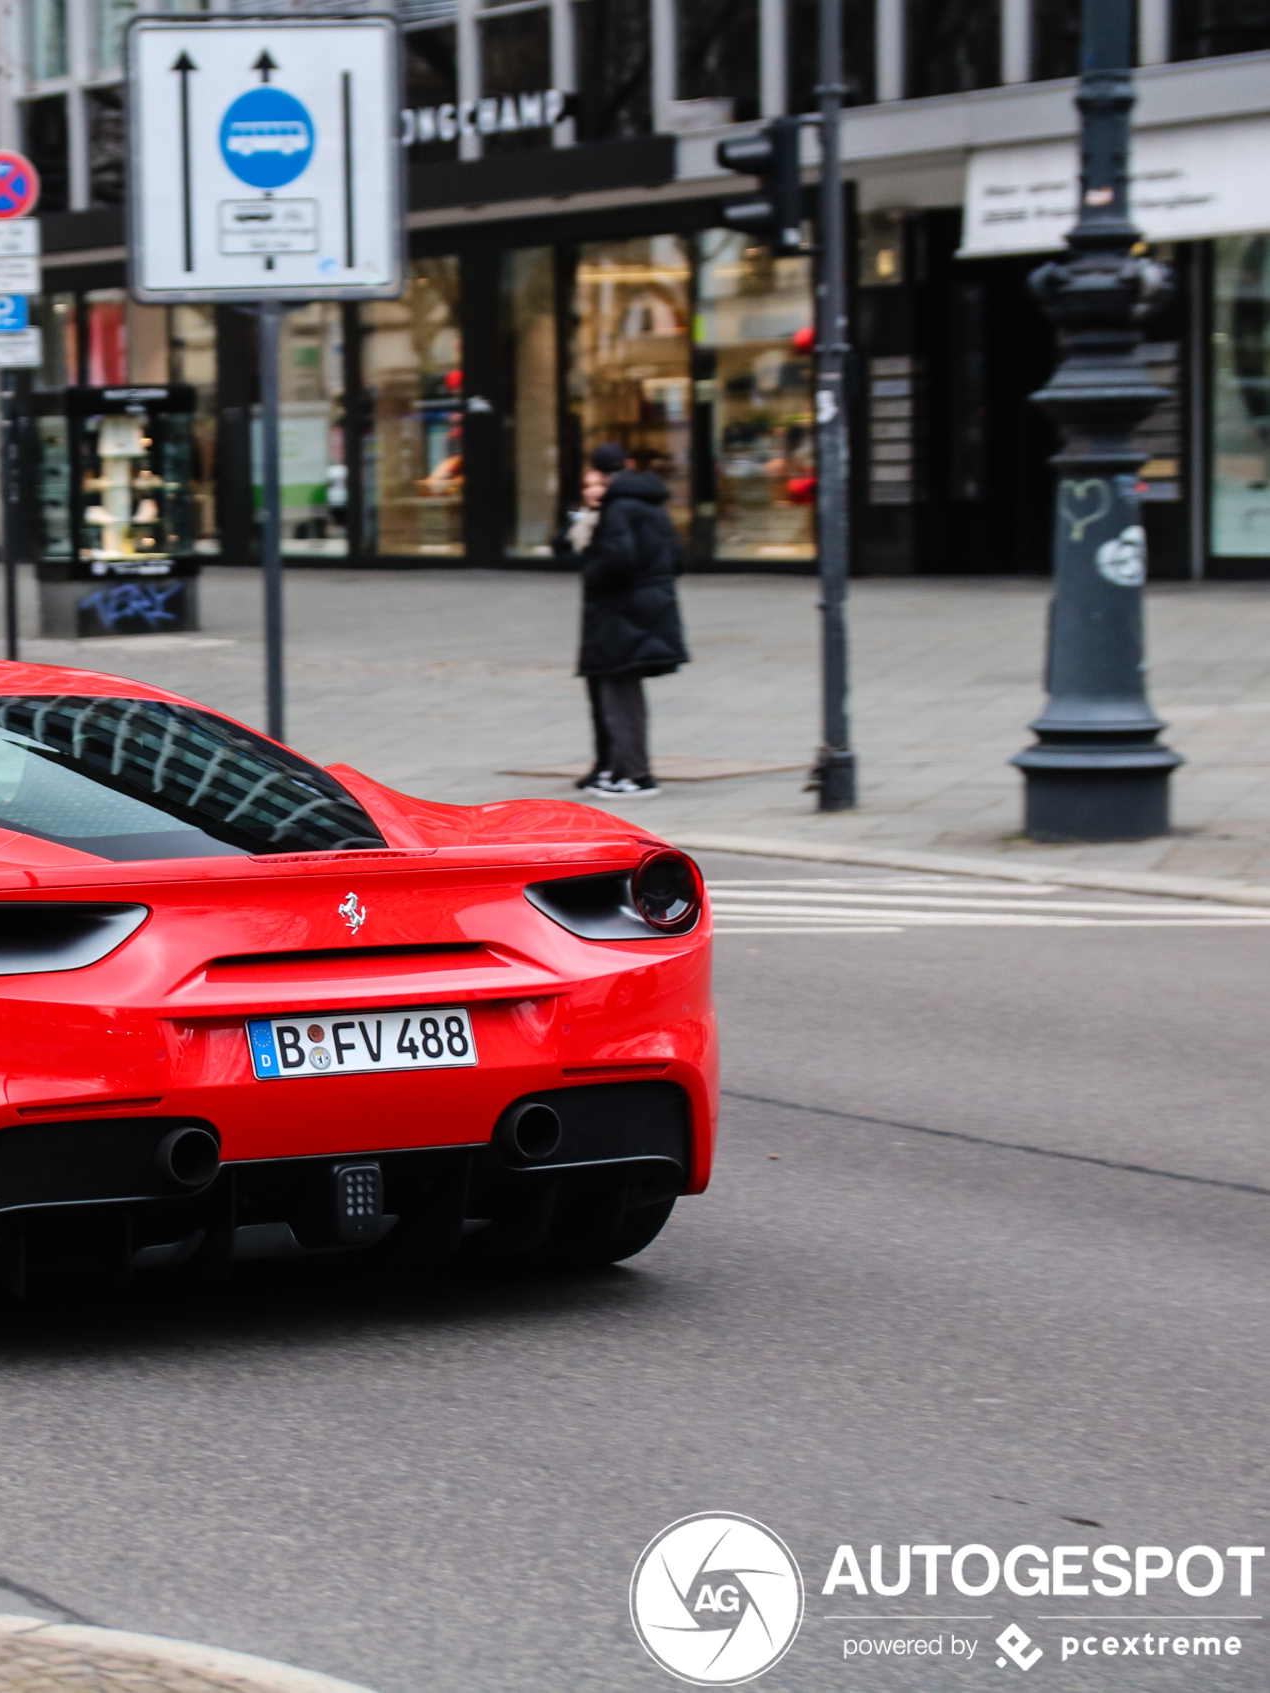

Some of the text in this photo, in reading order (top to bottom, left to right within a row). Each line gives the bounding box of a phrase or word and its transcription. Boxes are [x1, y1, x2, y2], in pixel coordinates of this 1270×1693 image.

[400, 88, 564, 147] ONGCHAMP
[261, 1054, 271, 1068] D
[276, 1015, 469, 1069] B FV 488
